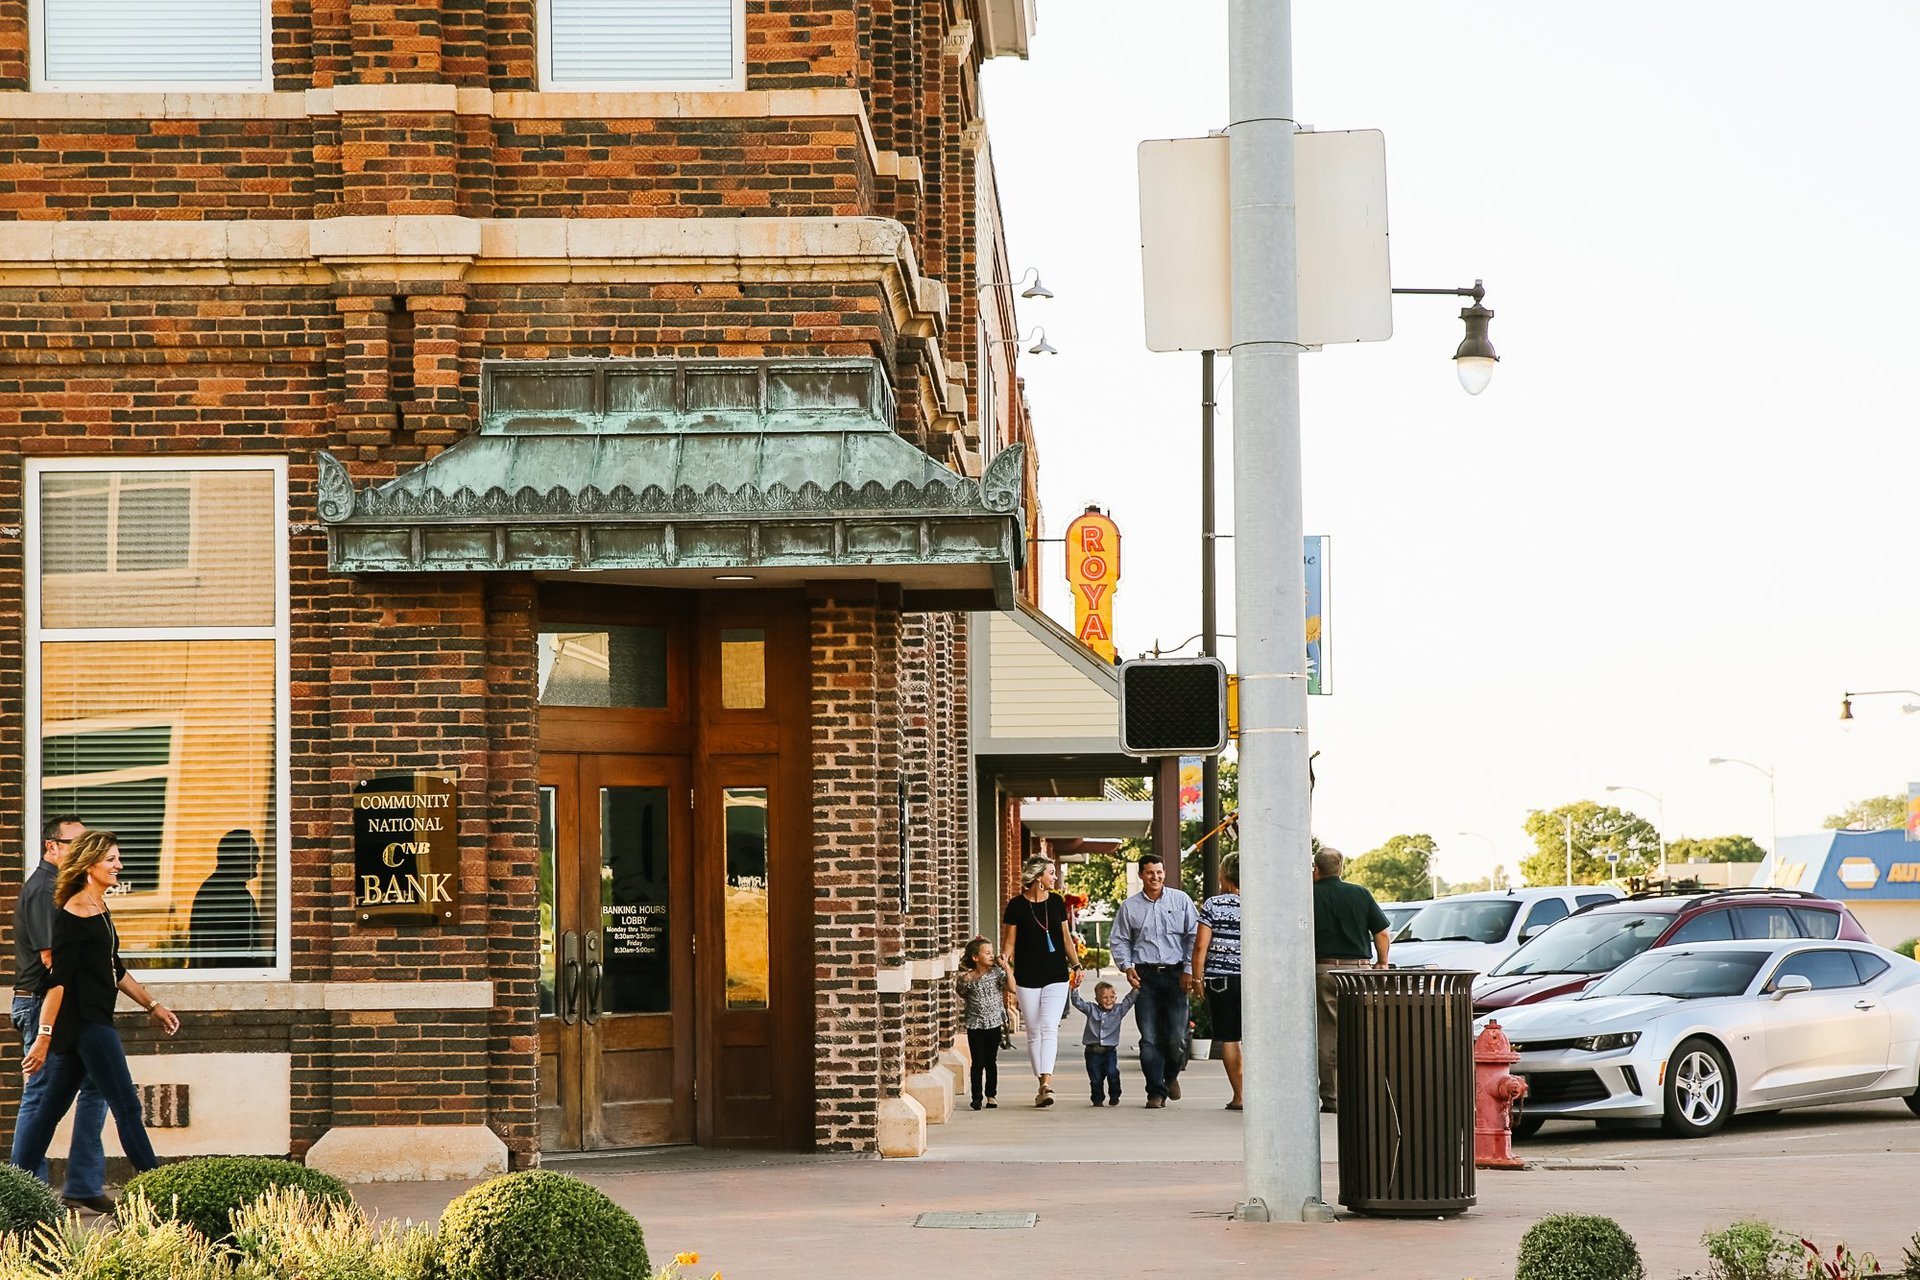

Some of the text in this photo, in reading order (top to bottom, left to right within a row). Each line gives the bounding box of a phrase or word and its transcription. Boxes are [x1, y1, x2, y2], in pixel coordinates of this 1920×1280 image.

[1078, 525, 1109, 650] ROYA
[360, 794, 450, 809] COMMUNITY
[368, 817, 444, 833] NATIONAL
[382, 841, 431, 868] CNB
[1887, 863, 1920, 882] AUT
[361, 873, 453, 904] BANK
[602, 905, 666, 914] BANKING HOURS
[621, 916, 647, 925] LOBBY
